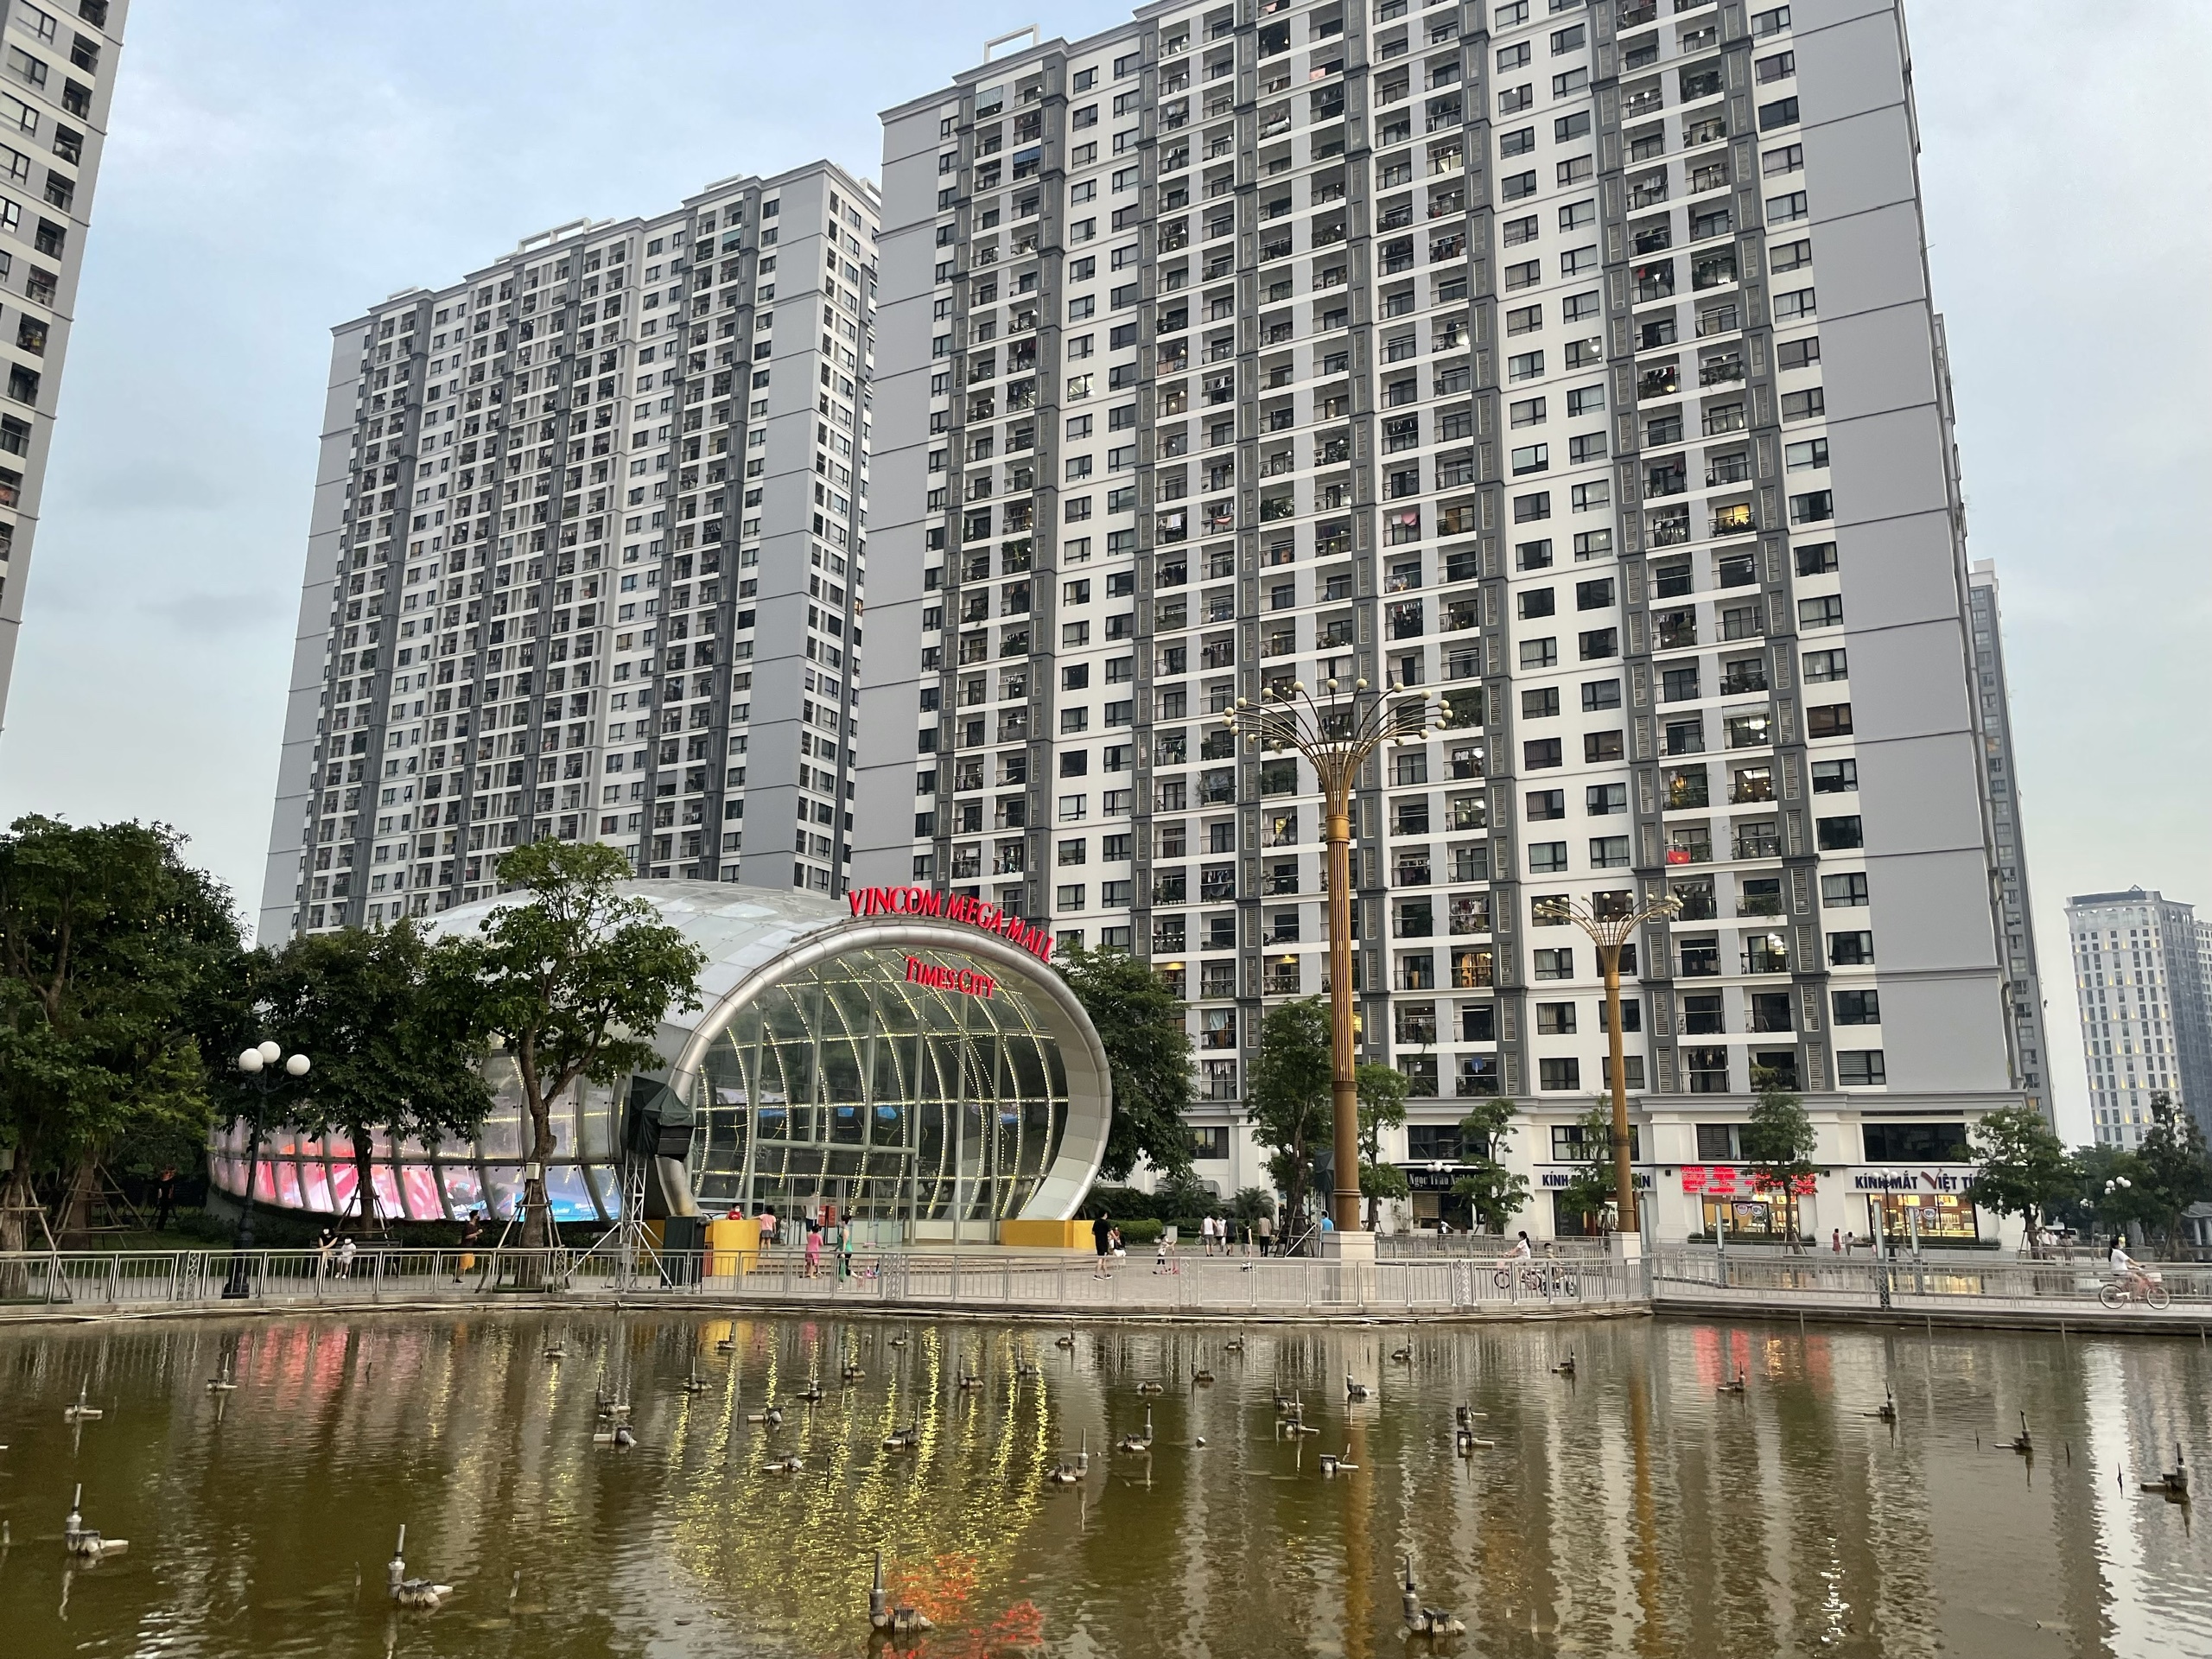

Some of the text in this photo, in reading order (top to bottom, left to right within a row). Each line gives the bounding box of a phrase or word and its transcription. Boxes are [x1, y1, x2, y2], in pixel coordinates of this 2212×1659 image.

[848, 887, 1055, 963] VINCOM MEGA MALL
[904, 955, 995, 999] TIMES CITY
[1409, 1173, 1428, 1187] Ngọc
[1541, 1171, 1568, 1186] KÍNH
[1921, 1167, 1957, 1192] VIỆT
